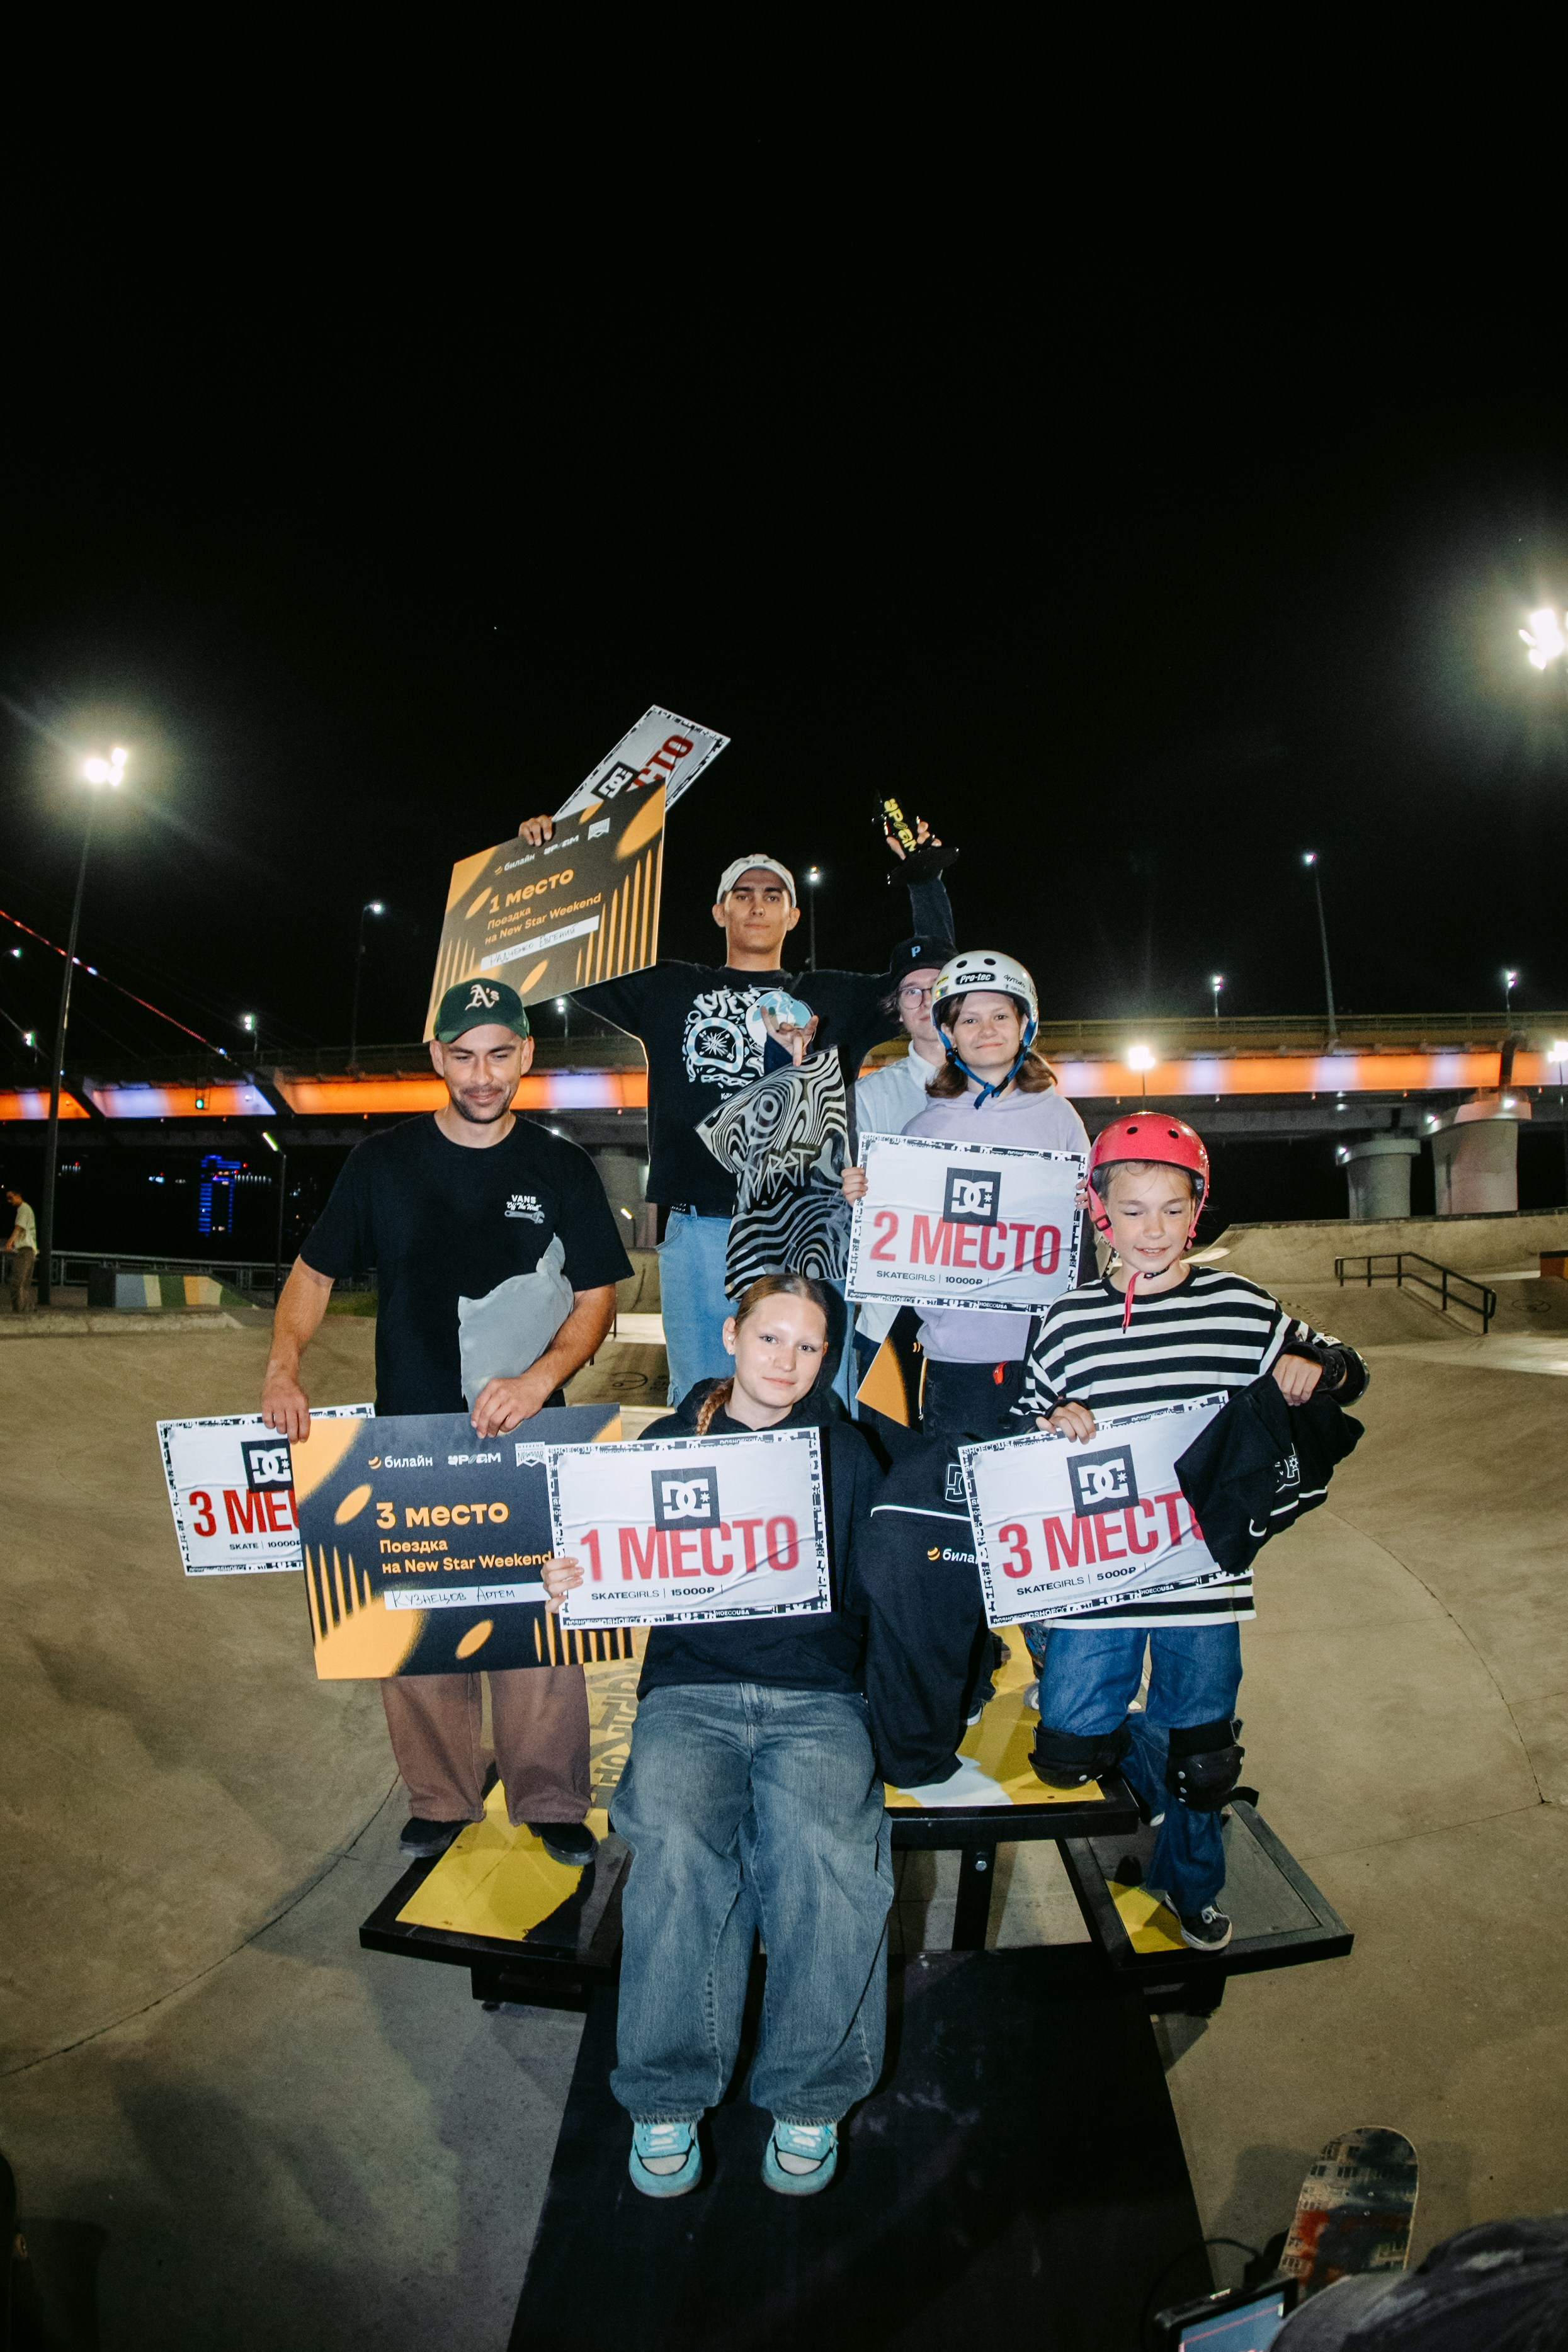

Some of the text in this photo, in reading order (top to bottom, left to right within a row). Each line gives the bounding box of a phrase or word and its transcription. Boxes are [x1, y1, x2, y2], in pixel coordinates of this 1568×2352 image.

[504, 853, 535, 872] билайн
[489, 869, 574, 914] 1 место
[485, 892, 602, 945] на New Star Weekend
[487, 907, 531, 931] Поездка
[959, 973, 992, 984] Pro-tec
[465, 984, 499, 1011] A's
[511, 1195, 536, 1205] VANS
[870, 1210, 1061, 1275] 2 МЕСТО
[876, 1270, 935, 1283] SKATEGIRLS
[384, 1454, 433, 1468] билайн
[188, 1491, 217, 1537] 3
[376, 1501, 509, 1530] 3 место
[229, 1542, 259, 1550] SKATE
[379, 1539, 448, 1554] Поездка
[580, 1514, 800, 1582] 1 МЕСТО
[942, 1548, 978, 1565] била
[998, 1523, 1033, 1579] 3
[382, 1550, 553, 1574] на New Star Weekend
[591, 1589, 660, 1601] SKATEGIRLS
[1016, 1576, 1084, 1596] SKATEGIRLS
